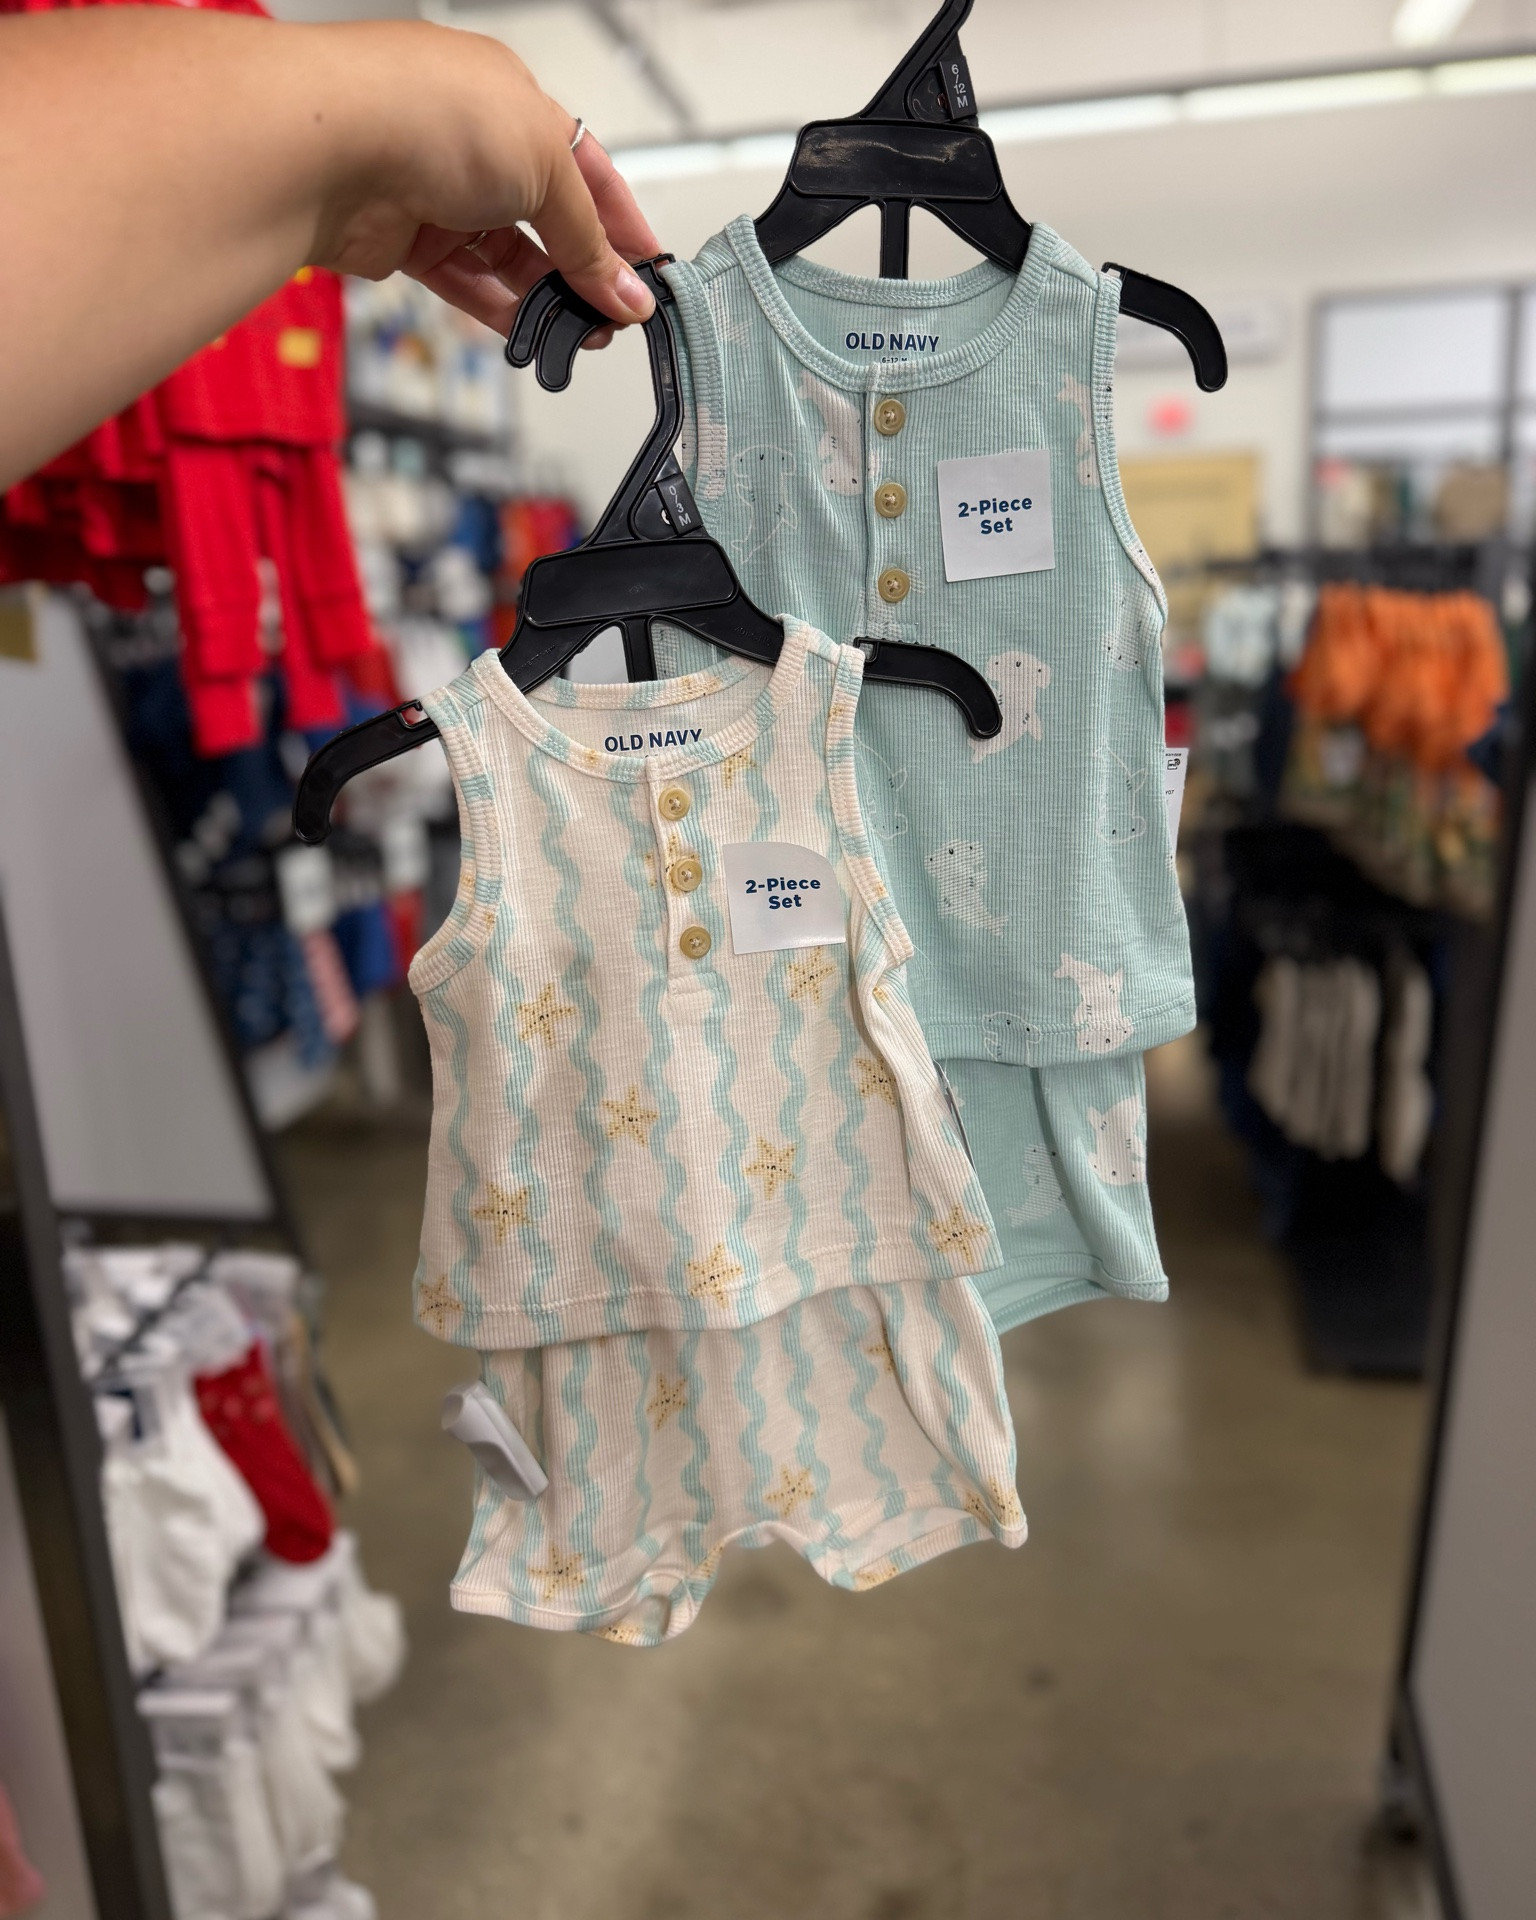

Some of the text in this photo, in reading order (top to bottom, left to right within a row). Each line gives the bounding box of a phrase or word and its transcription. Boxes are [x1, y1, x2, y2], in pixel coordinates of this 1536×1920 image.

[956, 95, 969, 109] M
[845, 332, 940, 353] OLD NAVY
[957, 497, 1033, 518] 2-Piece
[678, 512, 692, 527] M
[980, 517, 1013, 535] Set
[604, 728, 702, 752] OLD NAVY
[745, 876, 821, 894] 2-Piece
[768, 894, 802, 910] Set
